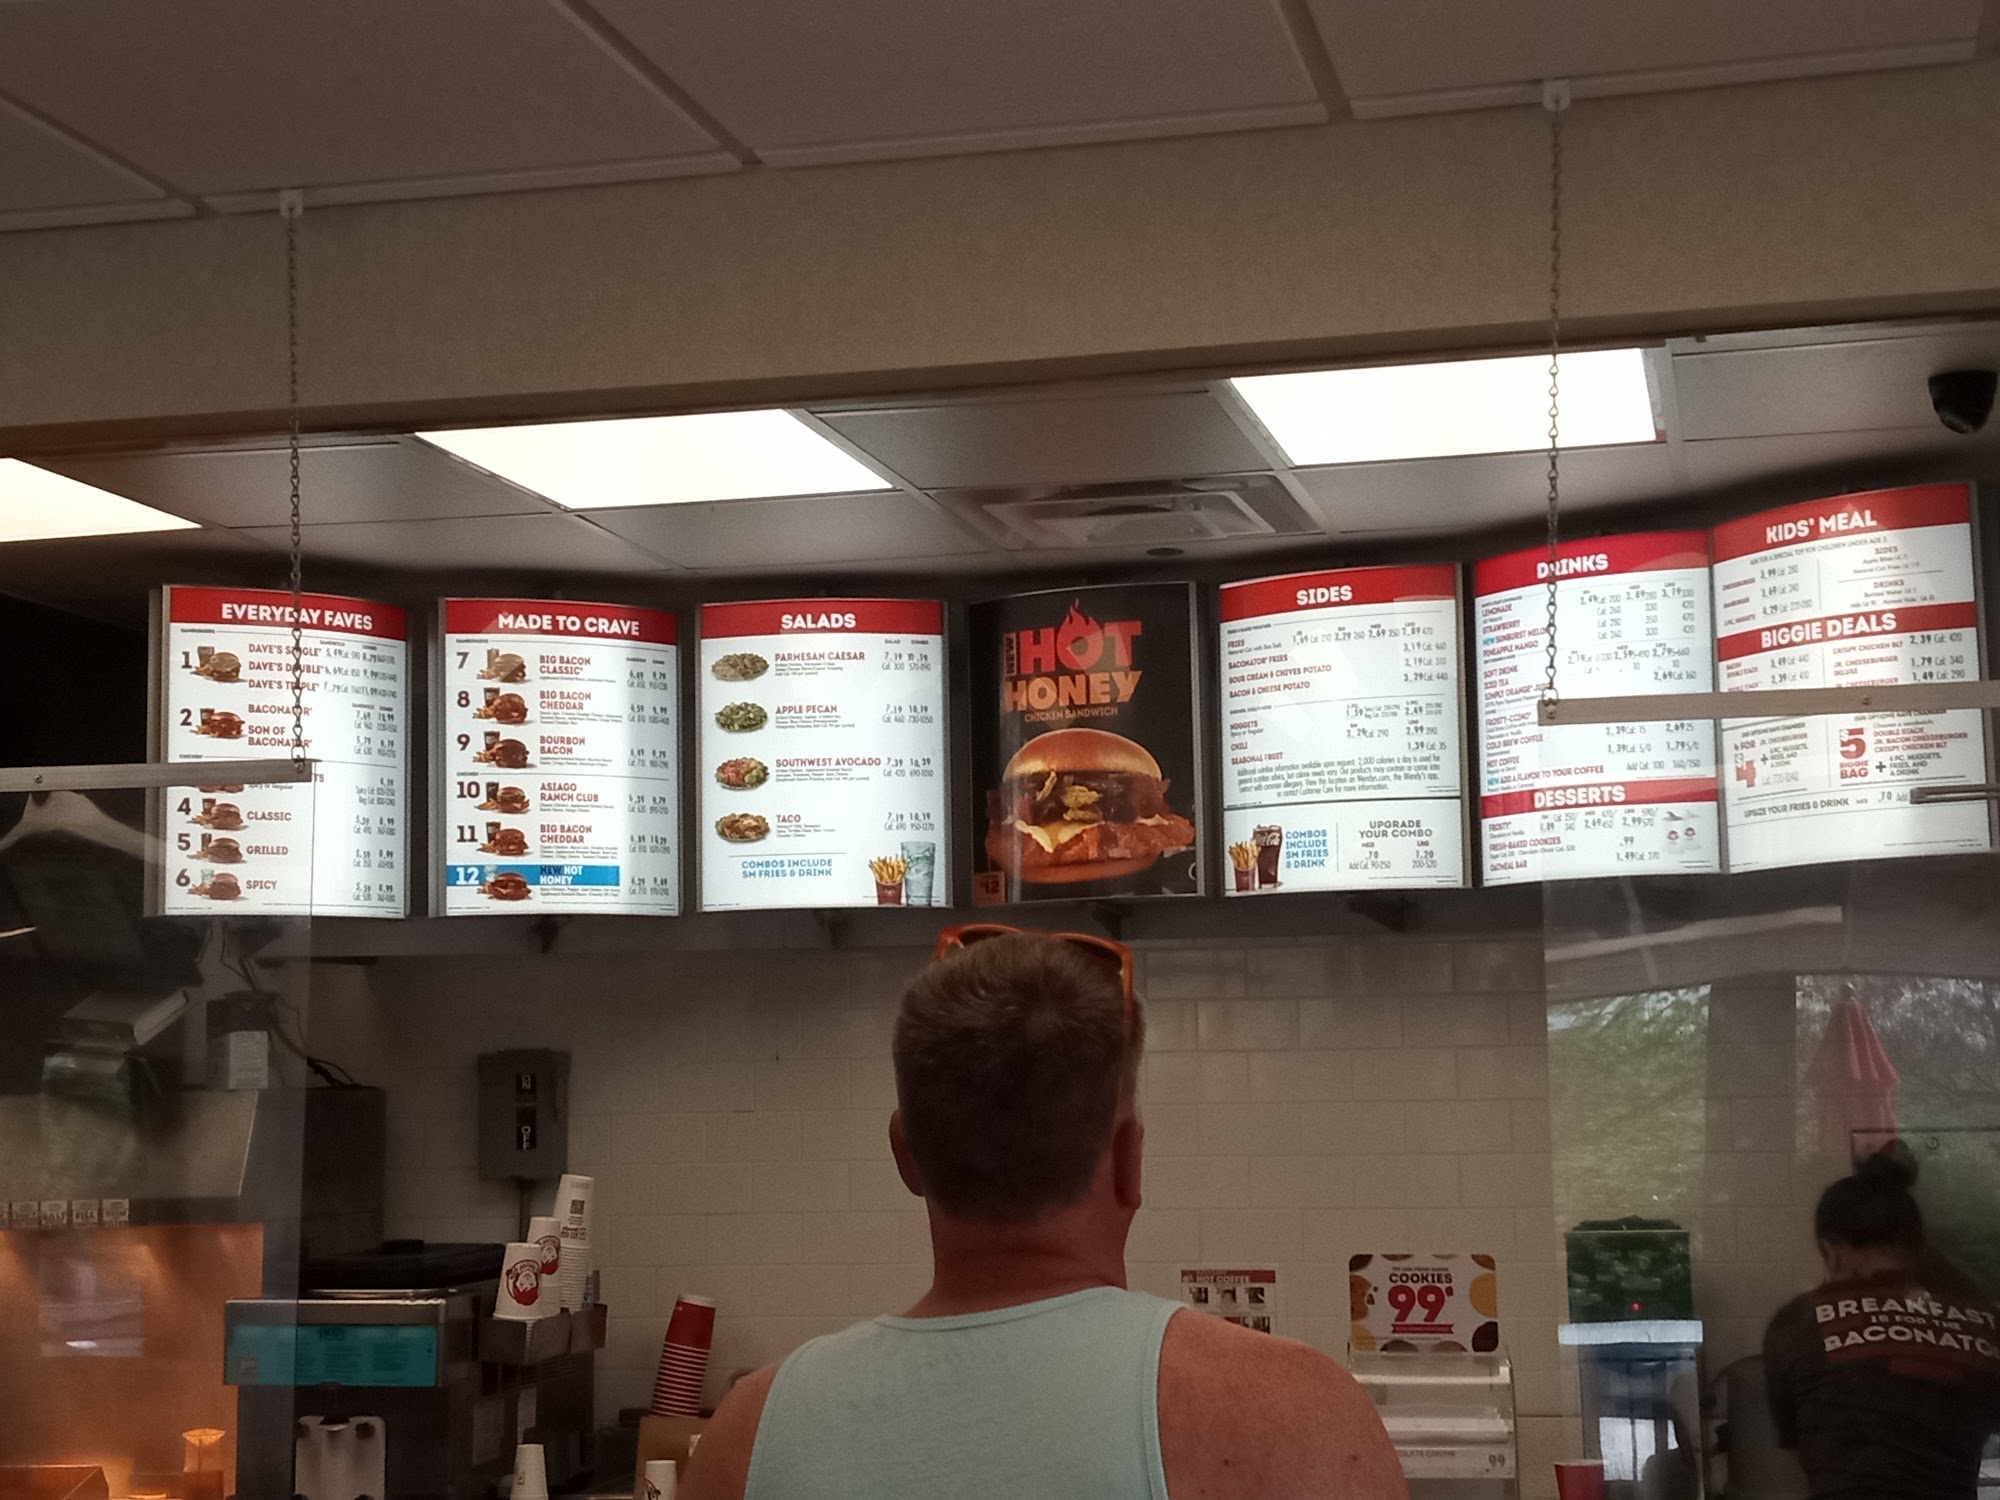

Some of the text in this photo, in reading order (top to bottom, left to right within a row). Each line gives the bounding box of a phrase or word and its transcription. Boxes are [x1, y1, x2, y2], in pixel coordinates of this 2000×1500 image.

[1766, 509, 1877, 544] KIDS' MEAL
[1874, 546, 1898, 555] SIDES
[1536, 553, 1609, 579] DRINKS
[1873, 580, 1904, 588] DRINKS
[1296, 584, 1353, 605] SIDES
[1482, 603, 1512, 617] LEMONADE
[221, 603, 373, 631] EVERYDAY FAVES
[781, 613, 857, 630] SALADS
[498, 613, 640, 636] MADE TO CRAVE
[1482, 619, 1521, 635] STRAWBERRY
[1761, 613, 1897, 649] BIGGIE DEALS
[1019, 608, 1142, 674] HOT
[1228, 639, 1245, 649] FRIES
[1833, 635, 1931, 655] CRISPY CHICKEN 2.39
[1483, 640, 1539, 657] PINEAPPLE MANGO
[181, 651, 193, 669] 1
[456, 652, 470, 669] 7
[539, 655, 591, 667] BIG BACON
[775, 652, 825, 662] PARMESAN
[827, 651, 866, 661] CAESAR
[1228, 654, 1288, 669] BACONATOR FRIES
[1845, 655, 1932, 668] CHEESEBURGER 1.79
[285, 663, 321, 675] DUBLE
[539, 664, 580, 675] CLASSIC
[1229, 664, 1332, 684] SOUR CREAM CHIVES POTATO
[1483, 665, 1518, 679] SOFT DRINK
[1498, 678, 1509, 686] TEA
[1912, 671, 1933, 682] 1.49
[539, 690, 592, 701] BIG BACON
[1005, 670, 1142, 713] HONEY
[1229, 681, 1310, 698] BACON CHEESE POTATO
[456, 691, 471, 708] 8
[539, 701, 584, 710] CHEDDAR
[775, 704, 928, 714] APPLE PECAN 10.19
[1024, 706, 1119, 723] CHICKEN SANDWICH
[180, 708, 192, 726] 2
[248, 725, 286, 735] SON OF
[1230, 720, 1258, 730] NUGGETS
[1873, 727, 1924, 737] DOUBLE STACK
[1886, 732, 1968, 744] BACON CHEESEBURGER
[456, 733, 471, 751] 9
[539, 736, 585, 745] BOURBON
[1230, 742, 1248, 751] CHILI
[1486, 734, 1543, 750] COLD BREW COFFEE
[539, 746, 573, 755] BACON
[1874, 741, 1947, 753] CRISPY CHICKEN BLT
[775, 757, 931, 768] SOUTHWEST AVOCADO 7.39 10.39
[1231, 751, 1283, 765] SEASONAL FRUIT
[1486, 756, 1520, 768] HOT COFFEE
[1840, 760, 1869, 768] BIGGIE
[1912, 760, 1928, 768] AND
[1517, 765, 1604, 781] FLAVOR YOUR COFFEE
[1840, 768, 1869, 779] BAG
[1896, 768, 1919, 776] DRINK
[456, 781, 480, 799] 10
[539, 782, 577, 791] ASIAGO
[539, 792, 599, 802] RANCH CLUB
[1534, 785, 1626, 809] DESSERTS
[177, 797, 191, 815] 4
[1768, 798, 1849, 814] YOUR FRIES DRINK
[247, 811, 292, 821] CLASSIC
[776, 812, 931, 823] TACO 10.19
[539, 824, 592, 834] BIG BACON
[1369, 819, 1421, 829] UPGRADE
[456, 825, 478, 843] 11
[539, 834, 585, 844] CHEDDAR
[1285, 829, 1327, 839] COMBOS
[1359, 829, 1433, 838] YOUR COMBO
[177, 833, 191, 851] 5
[1285, 839, 1328, 849] INCLUDE
[1489, 836, 1561, 851] FRESH-BAKED COOKIES
[246, 845, 288, 856] GRILLED
[1285, 849, 1329, 859] SM FRIES
[741, 859, 833, 869] COMBOS INCLUDE
[1294, 859, 1325, 868] DRINK
[1489, 860, 1527, 872] OATMEAL BAR
[456, 866, 480, 885] 12
[564, 866, 583, 875] HOT
[742, 867, 832, 879] SM FRIES DRINK
[176, 868, 190, 887] 6
[540, 875, 573, 885] HONEY
[246, 879, 278, 890] SPICY
[1388, 1272, 1453, 1284] COOKIES
[1815, 1296, 1997, 1330] BREAKFAST
[1895, 1315, 1962, 1332] FOR THE
